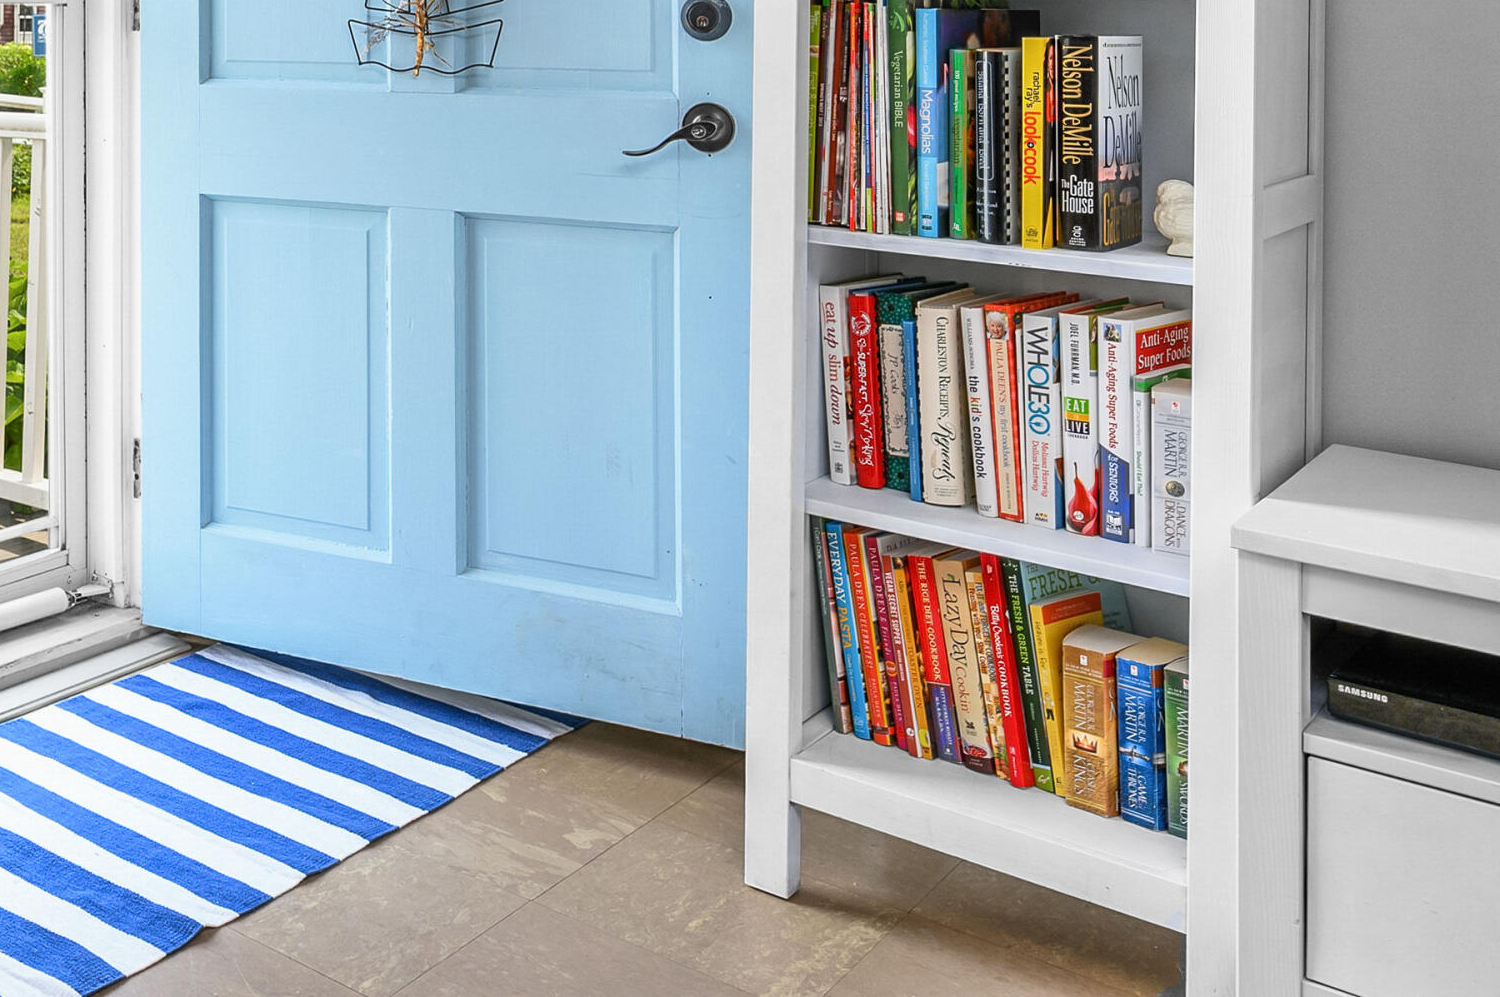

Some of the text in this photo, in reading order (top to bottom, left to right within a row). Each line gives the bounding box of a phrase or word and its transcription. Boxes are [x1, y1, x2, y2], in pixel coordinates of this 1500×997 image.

[892, 50, 904, 128] Vegetarian BIBLE
[1026, 87, 1034, 108] ray's
[1033, 72, 1041, 103] rachael
[1107, 55, 1140, 109] Nelson
[1062, 44, 1094, 165] Nelson DeMille
[920, 89, 933, 154] Magnolias
[952, 115, 962, 165] vegetarian
[1103, 114, 1142, 168] DeMille
[1070, 175, 1093, 197] Gate
[1062, 191, 1093, 214] House
[825, 302, 837, 323] eat
[823, 327, 838, 348] up
[936, 317, 949, 373] CHARLESTON
[1070, 323, 1079, 338] JOEL
[1140, 326, 1189, 349] Anti-Aging
[828, 354, 841, 381] slim
[1138, 344, 1191, 371] Super Foods
[1026, 326, 1051, 434] WHOLE30
[1071, 373, 1080, 385] M.D.
[830, 385, 842, 425] down
[995, 341, 1011, 468] PAULA DEEN'S my first cookbook
[1066, 398, 1086, 412] EAT
[1106, 343, 1119, 449] Anti-Aging Super Foods
[969, 376, 987, 479] the kid's cookbook
[1066, 421, 1088, 434] LIVE
[859, 430, 874, 466] Cooking
[1108, 454, 1118, 462] for
[1164, 430, 1177, 477] MARTIN
[1178, 431, 1187, 462] GEORGE
[1031, 463, 1039, 491] Hartwig
[1040, 442, 1049, 497] Melissa Hartwig
[1109, 462, 1119, 502] SENIORS
[1164, 500, 1175, 546] DRAGONS
[1176, 506, 1186, 537] DANCE
[869, 547, 882, 581] PAULA
[1026, 563, 1039, 574] THE
[827, 532, 851, 649] EVERYDAY PASTA
[874, 585, 886, 613] DEEN
[975, 582, 986, 600] FIX-IT
[1008, 574, 1019, 593] THE
[1028, 570, 1082, 601] FRESH
[848, 544, 873, 669] PAULA DEEN CELEBRATES!
[885, 572, 902, 645] VEGAN SECRET SUPPER
[917, 561, 942, 681] THE RICE DIET COOKBOOK
[979, 602, 987, 614] and
[1012, 595, 1025, 624] FRESH
[881, 625, 892, 656] Friends
[942, 577, 970, 714] Lazy Day Cookin'
[976, 641, 985, 654] Slow
[1017, 633, 1029, 664] GREEN
[1035, 621, 1043, 645] Heaven
[985, 647, 997, 682] COOKBOOK
[990, 604, 1012, 717] Betty Crocker's COOKBOOK
[905, 646, 916, 682] TOASTER
[911, 684, 922, 709] OVEN
[1022, 666, 1034, 695] TABLE
[1338, 684, 1388, 703] SAMSUNG
[895, 705, 903, 722] DEEN
[1074, 682, 1086, 730] MARTIN
[1086, 684, 1095, 717] GEORGE
[1137, 697, 1147, 729] GEORGE
[1125, 693, 1138, 742] MARTIN
[1177, 707, 1188, 756] MARTIN
[1074, 755, 1087, 795] KINGS
[1086, 763, 1096, 791] CLASH
[1127, 768, 1138, 808] THRONES
[1138, 775, 1148, 803] GAME
[1179, 781, 1188, 824] SWORDS
